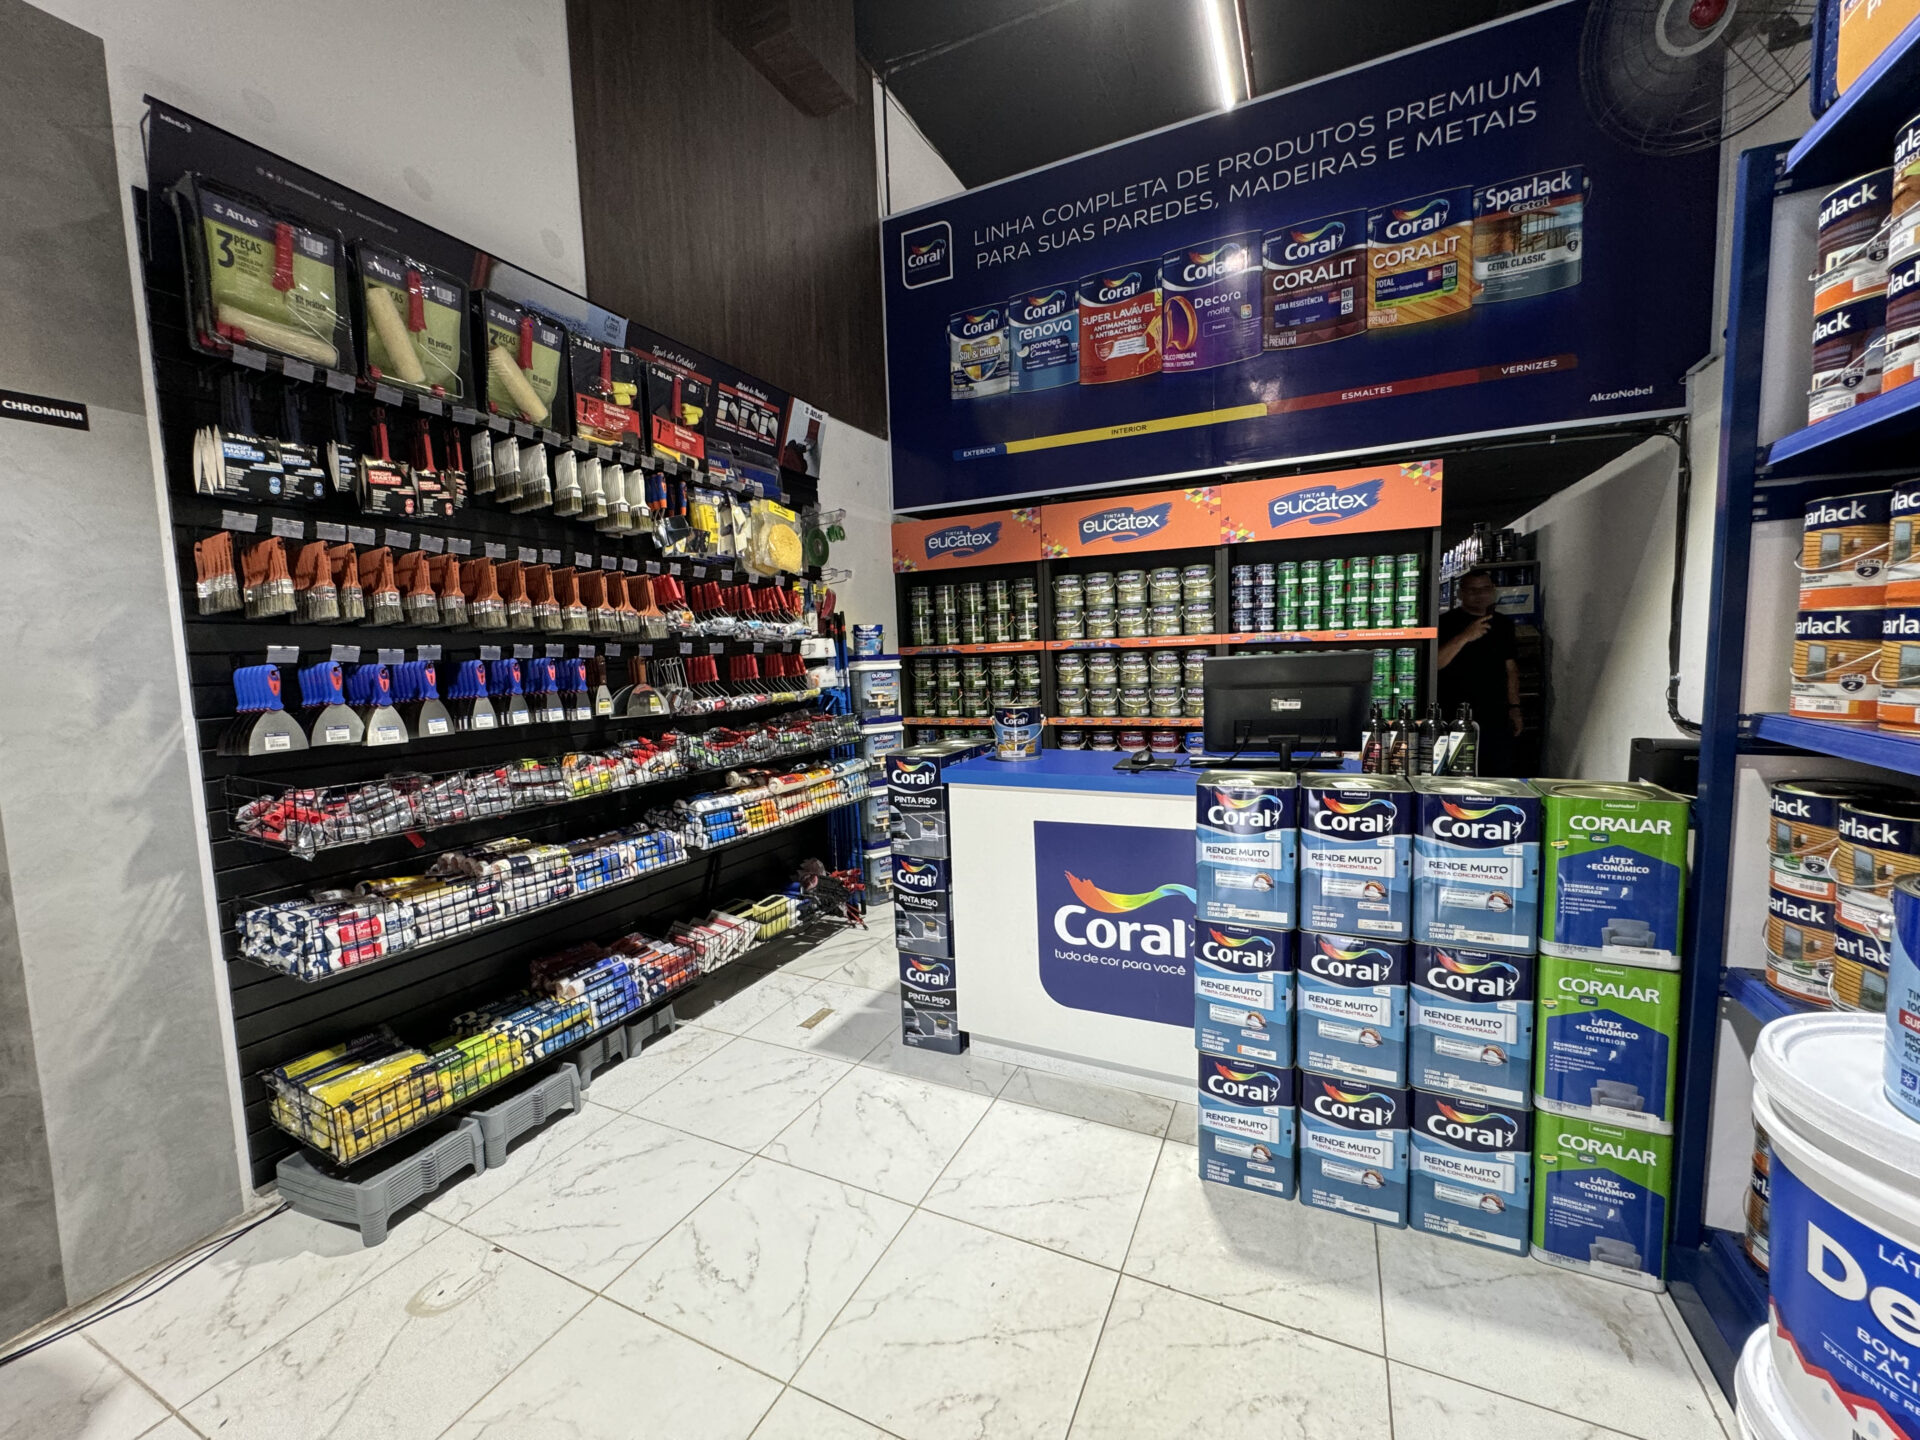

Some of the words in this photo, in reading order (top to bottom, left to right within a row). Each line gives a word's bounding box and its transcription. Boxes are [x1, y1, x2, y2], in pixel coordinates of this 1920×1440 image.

[974, 215, 1035, 246] LINHA
[1042, 177, 1168, 226] COMPLETA
[1177, 163, 1210, 190] DE
[1218, 115, 1376, 177] PRODUTOS
[1386, 66, 1541, 129] PREMIUM
[976, 241, 1032, 270] PARA
[1037, 223, 1096, 253] SUAS
[1103, 190, 1220, 236] PAREDES,
[1229, 145, 1377, 202] MADEIRAS
[1388, 137, 1406, 160] E
[1416, 101, 1538, 156] METAIS
[1486, 171, 1572, 212] Sparlack
[1509, 197, 1550, 215] Cetol
[226, 208, 259, 228] ATLAS
[1386, 212, 1441, 239] Coral
[216, 228, 235, 268] 3
[1284, 235, 1336, 261] Coral
[1373, 235, 1461, 270] CORALIT
[907, 250, 941, 268] Coral
[1487, 258, 1509, 272] CETOL
[1510, 252, 1546, 268] CLASSIC
[377, 264, 401, 281] ATLAS
[1273, 258, 1357, 292] CORALIT
[1099, 282, 1138, 302] Coral
[1376, 278, 1395, 288] TOTAL
[1194, 290, 1241, 309] Decora
[497, 312, 517, 326] ATLAS
[1024, 302, 1062, 321] Coral
[1082, 311, 1111, 326] SUPER
[1113, 302, 1157, 322] LAVÁVEL
[963, 318, 995, 336] Coral
[1019, 319, 1072, 341] renova
[1094, 317, 1143, 332] ANTIMANCHAS
[583, 340, 601, 353] ATLAS
[1501, 359, 1558, 374] VERNIZES
[1341, 385, 1393, 400] ESMALTES
[1589, 385, 1653, 403] AkzoNobel
[2, 400, 83, 421] CHROMIUM
[1111, 424, 1148, 435] INTERIOR
[963, 446, 996, 457] EXTERIOR
[1273, 491, 1369, 518] eucatex
[1083, 512, 1160, 534] eucatex
[928, 532, 992, 550] eucatex
[1863, 567, 1873, 577] 2
[1848, 681, 1857, 691] 2
[1003, 717, 1025, 725] Coral
[891, 769, 930, 785] Coral
[894, 795, 917, 805] PINTA
[918, 796, 937, 806] PISO
[1207, 805, 1272, 828] Coral
[1313, 809, 1384, 833] Coral
[1568, 815, 1673, 836] CORALAR
[1431, 815, 1511, 842] Coral
[1206, 845, 1237, 856] RENDE
[1238, 847, 1270, 858] MUITO
[1311, 852, 1345, 863] RENDE
[1347, 854, 1382, 865] MUITO
[1602, 855, 1634, 866] LÁTEX
[1333, 862, 1378, 872] CONCENTRADA
[1428, 860, 1468, 873] RENDE
[1470, 862, 1509, 875] MUITO
[1453, 871, 1504, 882] CONCENTRADA
[1586, 863, 1651, 875] +ECONÔMICO
[1810, 862, 1819, 873] 2
[896, 868, 933, 888] Coral
[1597, 873, 1639, 883] INTERIOR
[898, 893, 919, 905] PINTA
[920, 897, 939, 908] PISO
[1053, 904, 1187, 959] Coral
[1054, 948, 1082, 962] tudo
[1082, 953, 1099, 964] de
[1099, 956, 1120, 968] cor
[1121, 958, 1151, 971] para
[1153, 964, 1187, 976] você
[1202, 941, 1264, 969] Coral
[906, 968, 944, 986] Coral
[1310, 954, 1380, 982] Coral
[1200, 979, 1231, 992] RENDE
[1232, 985, 1263, 998] MUITO
[1427, 967, 1505, 998] Coral
[1558, 976, 1661, 1005] CORALAR
[908, 991, 931, 1003] PINTA
[931, 995, 951, 1007] PISO
[1308, 993, 1343, 1008] RENDE
[1344, 1000, 1378, 1014] MUITO
[1328, 1005, 1374, 1018] CONCENTRADA
[1423, 1008, 1463, 1023] RENDE
[1463, 1015, 1503, 1030] MUITO
[1446, 1022, 1498, 1036] CONCENTRADA
[1575, 1024, 1639, 1041] +ECONÔMICO
[1591, 1018, 1623, 1031] LÁTEX
[1585, 1034, 1627, 1047] INTERIOR
[1207, 1075, 1269, 1103] Coral
[1314, 1095, 1383, 1126] Coral
[1205, 1111, 1237, 1125] RENDE
[1237, 1117, 1269, 1131] MUITO
[1427, 1114, 1504, 1149] Coral
[1311, 1133, 1346, 1149] RENDE
[1347, 1141, 1382, 1156] MUITO
[1331, 1145, 1377, 1161] CONCENTRADA
[1557, 1133, 1657, 1168] CORALAR
[1423, 1154, 1463, 1171] RENDE
[1463, 1164, 1501, 1179] MUITO
[1446, 1168, 1497, 1185] CONCENTRADA
[1589, 1176, 1621, 1190] LÁTEX
[1573, 1181, 1637, 1200] +ECONÔMICO
[1584, 1191, 1625, 1206] INTERIOR
[1857, 1326, 1911, 1370] BOM
[1823, 1340, 1900, 1403] EXCELENTE
